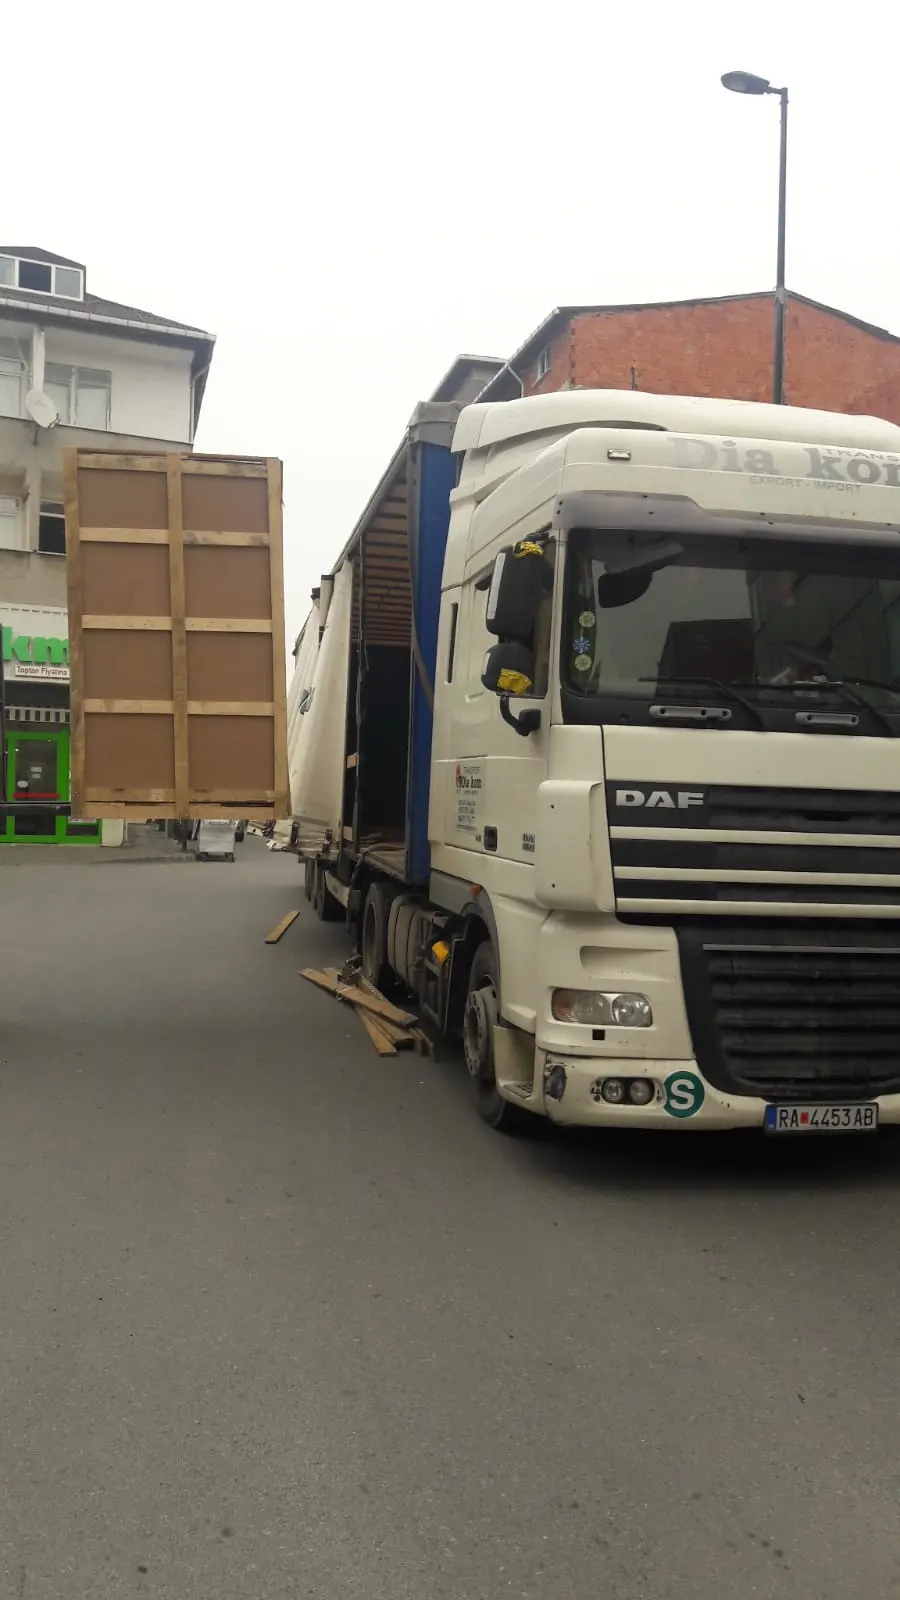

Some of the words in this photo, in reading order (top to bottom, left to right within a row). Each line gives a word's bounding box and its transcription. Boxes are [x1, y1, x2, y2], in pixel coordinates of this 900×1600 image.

[667, 437, 780, 475] Dia
[750, 475, 800, 487] EXPORT
[813, 480, 862, 493] IMPORT
[615, 789, 704, 809] DAF
[669, 1078, 695, 1110] S
[778, 1109, 799, 1128] RA
